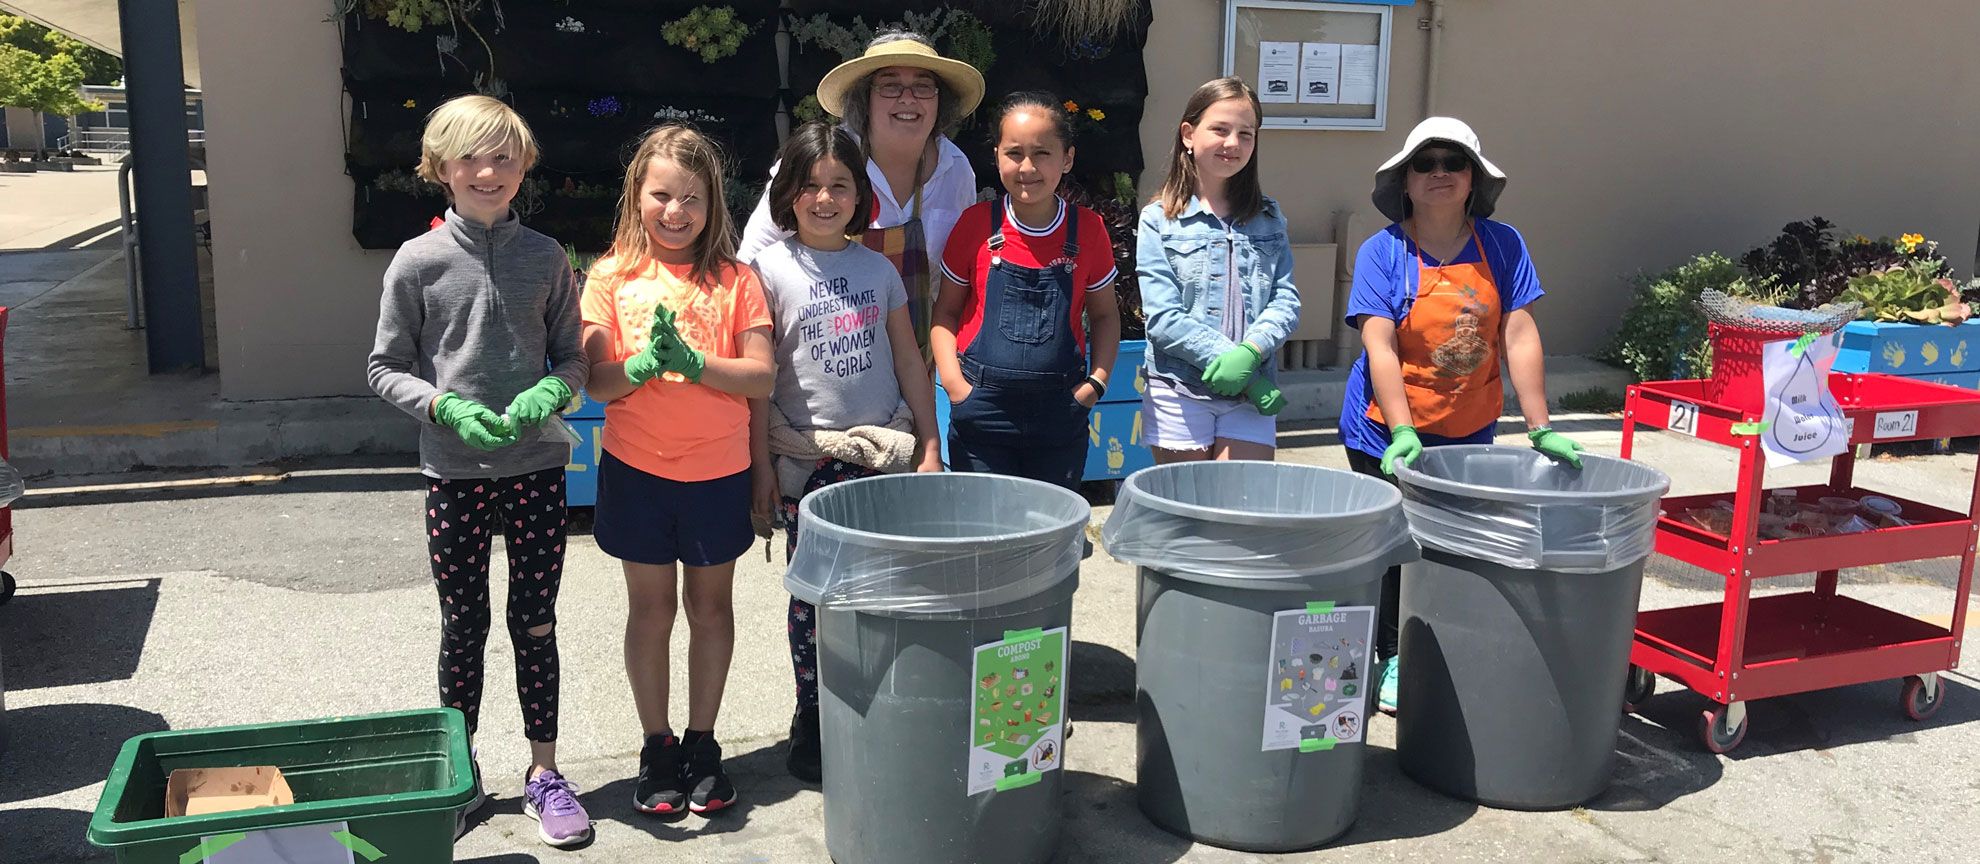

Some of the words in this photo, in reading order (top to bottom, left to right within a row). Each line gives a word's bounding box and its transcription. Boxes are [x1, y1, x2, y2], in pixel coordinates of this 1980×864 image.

[809, 276, 849, 300] NEVER
[797, 289, 876, 322] UNDERESTIMATE
[800, 322, 823, 343] THE
[833, 305, 880, 337] POWER
[811, 342, 827, 361] OF
[829, 327, 876, 357] WOMEN
[824, 359, 835, 374] &
[836, 351, 873, 378] GIRLS
[1791, 394, 1807, 405] Milk
[1670, 404, 1696, 433] 21
[1876, 416, 1900, 432] Room
[1901, 413, 1914, 432] 21
[1793, 432, 1817, 441] Juice
[1298, 612, 1347, 625] GARBAGE
[1308, 625, 1334, 633] BASURA
[997, 639, 1042, 658] COMPOST
